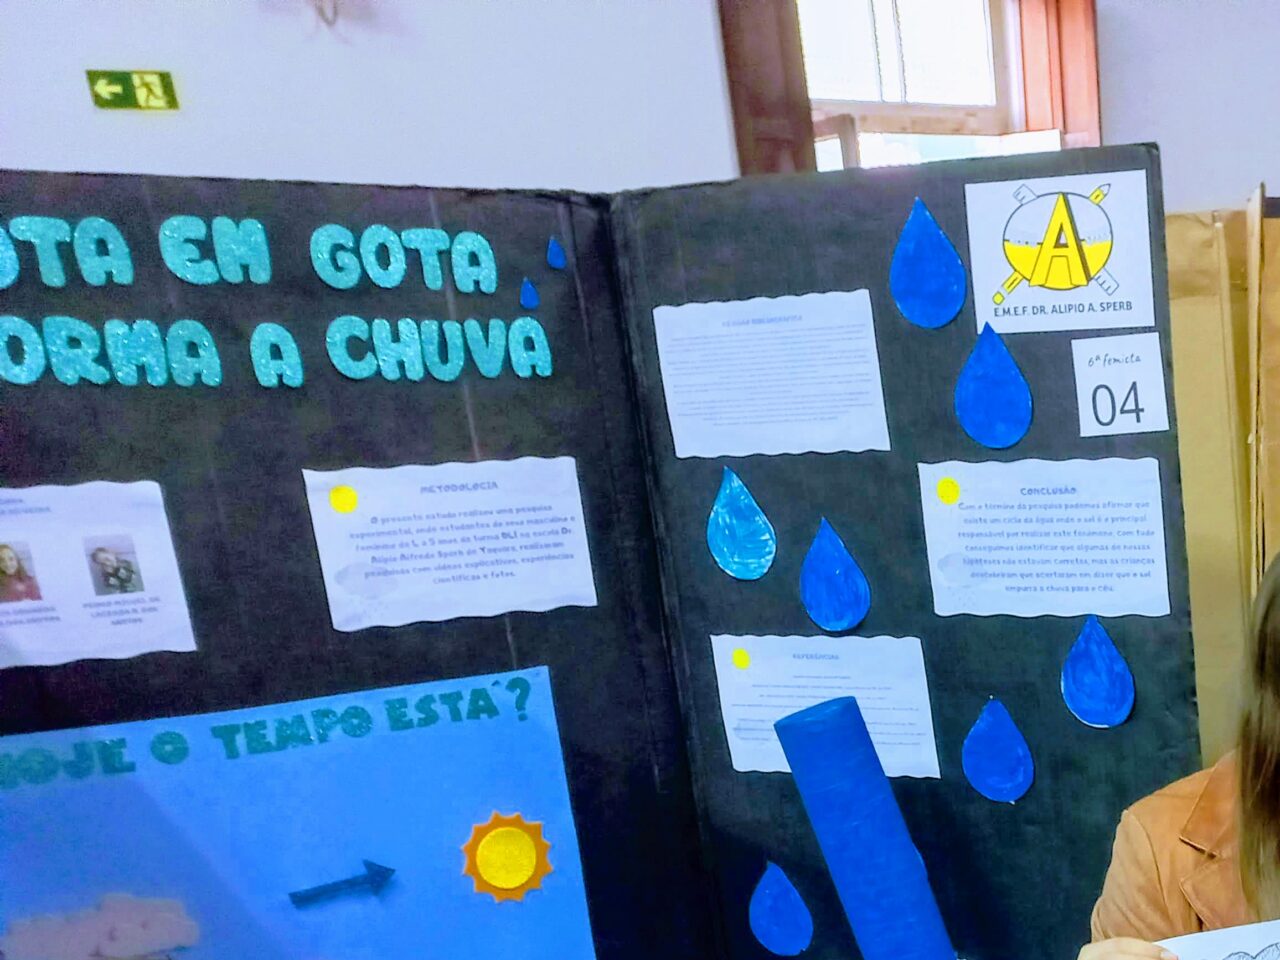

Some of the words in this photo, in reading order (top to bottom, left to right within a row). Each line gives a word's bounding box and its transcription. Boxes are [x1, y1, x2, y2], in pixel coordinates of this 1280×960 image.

[159, 215, 272, 286] EM
[310, 223, 499, 295] GOTA
[993, 305, 1028, 317] E.M.E.F.
[1032, 304, 1049, 315] DR.
[1051, 302, 1085, 314] ALIPIO
[1087, 302, 1098, 312] A.
[1100, 300, 1133, 312] SPERB
[249, 322, 304, 388] A
[325, 315, 553, 382] CHUVA
[1091, 380, 1145, 427] 04
[1020, 485, 1078, 496] CONCLUSÃO
[149, 729, 190, 765] O
[209, 704, 375, 760] TEMPO
